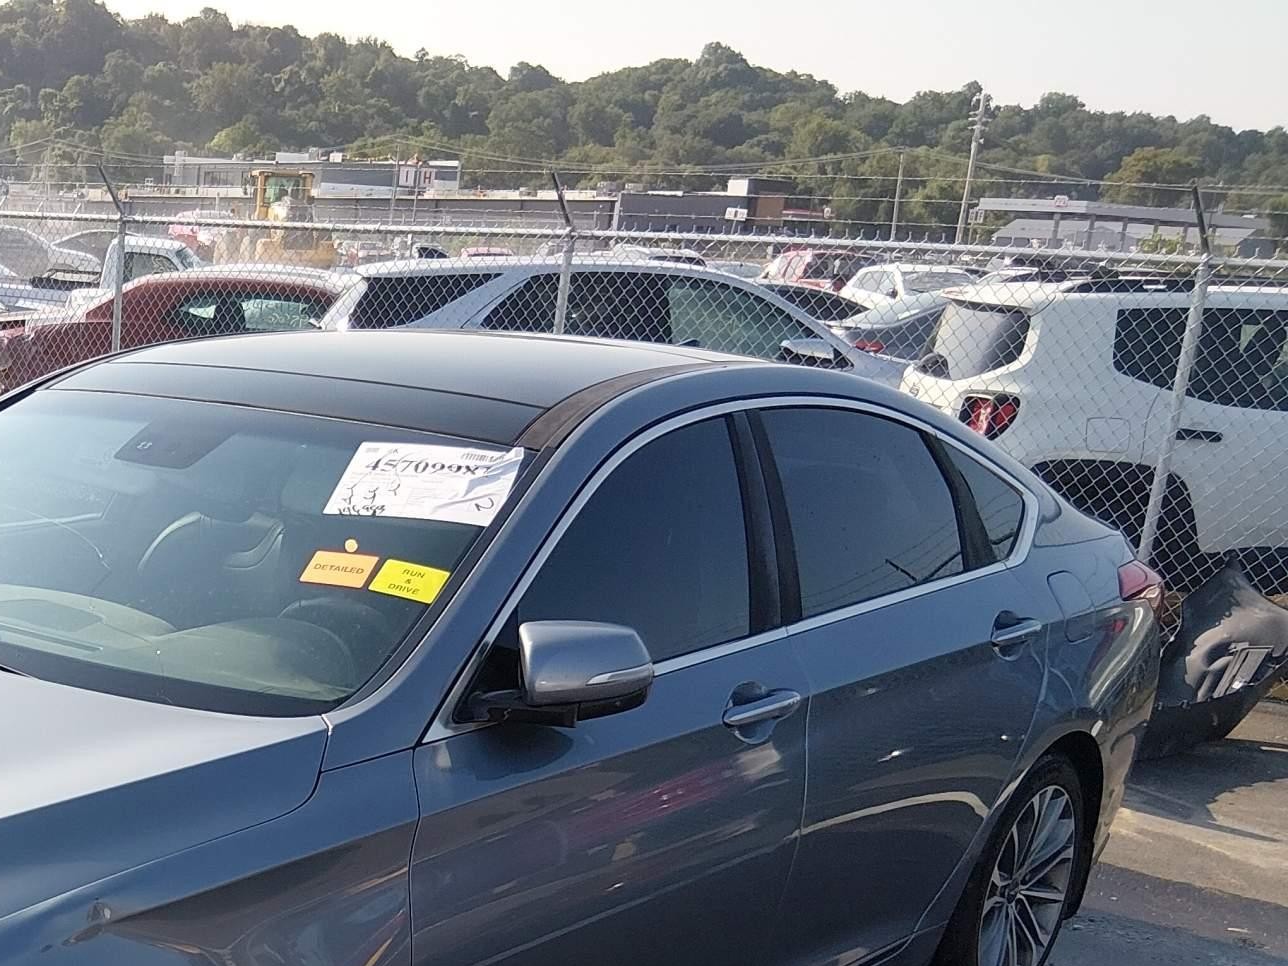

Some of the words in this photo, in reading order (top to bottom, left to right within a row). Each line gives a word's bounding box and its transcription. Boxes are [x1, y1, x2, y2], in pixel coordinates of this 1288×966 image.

[313, 563, 365, 575] DETAILED
[402, 569, 426, 579] RUN
[388, 583, 420, 595] DRIVE
